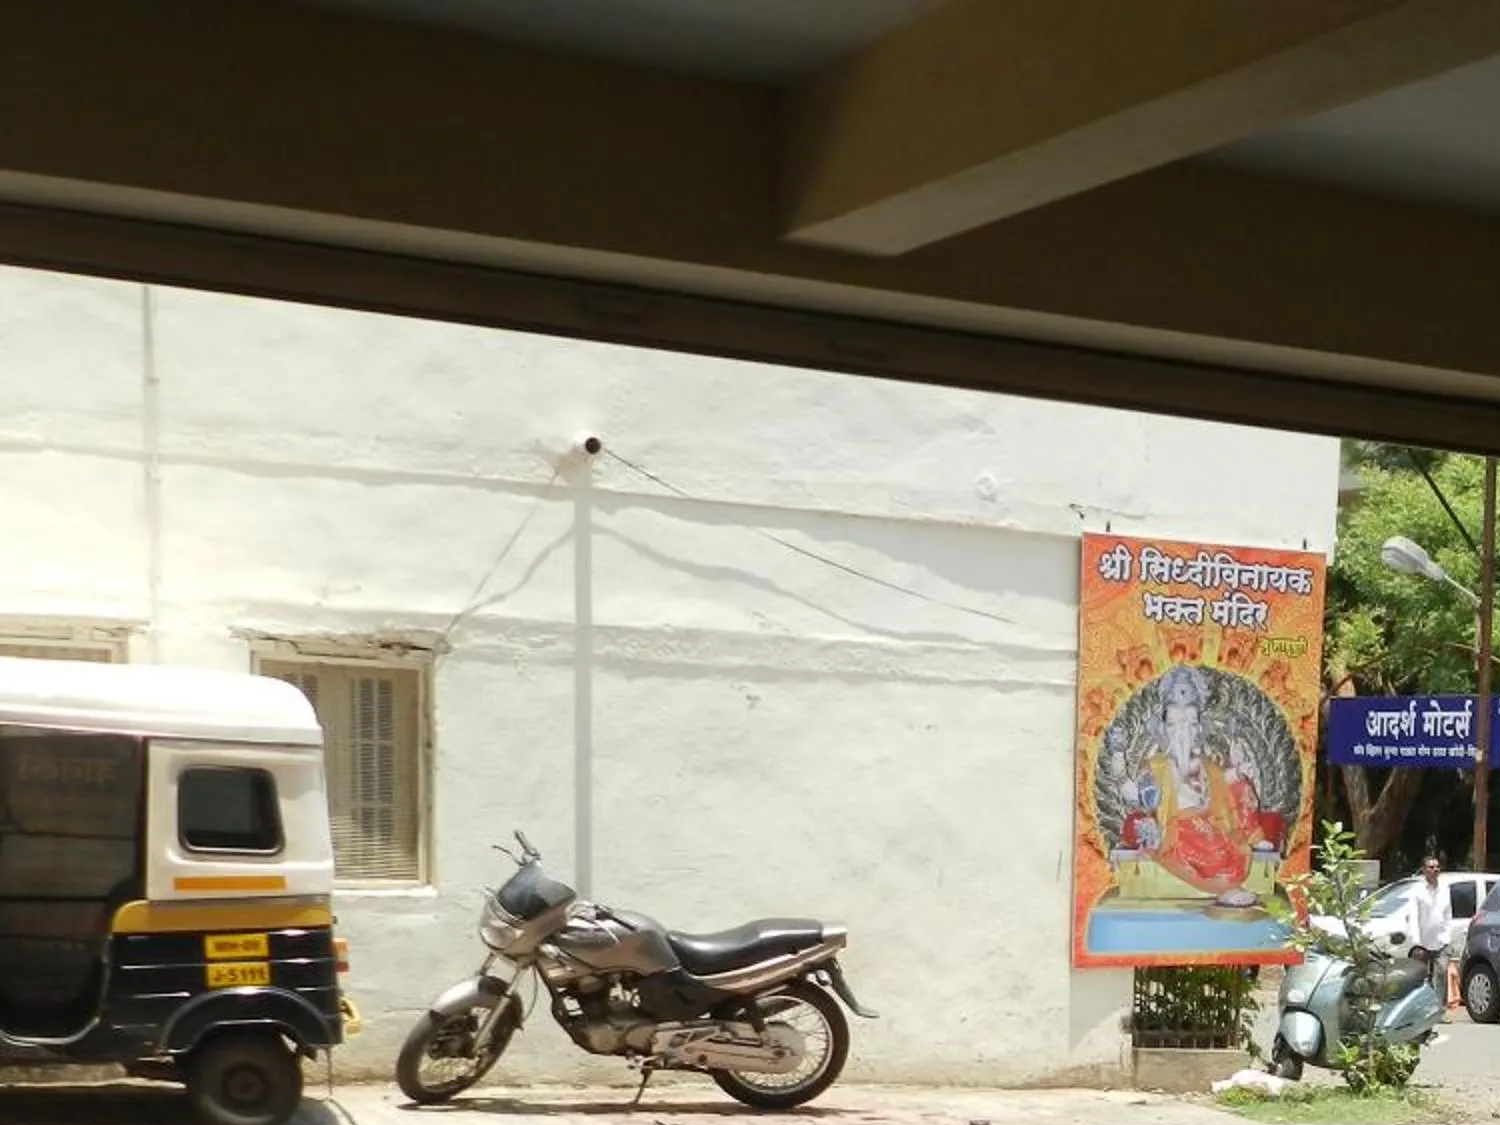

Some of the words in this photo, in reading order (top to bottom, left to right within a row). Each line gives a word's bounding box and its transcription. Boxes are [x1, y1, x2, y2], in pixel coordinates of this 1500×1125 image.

[1100, 545, 1132, 581] श्री
[1211, 591, 1269, 630] मंदिर
[1366, 700, 1417, 740] आदर्श
[1422, 700, 1473, 739] मोटर्स
